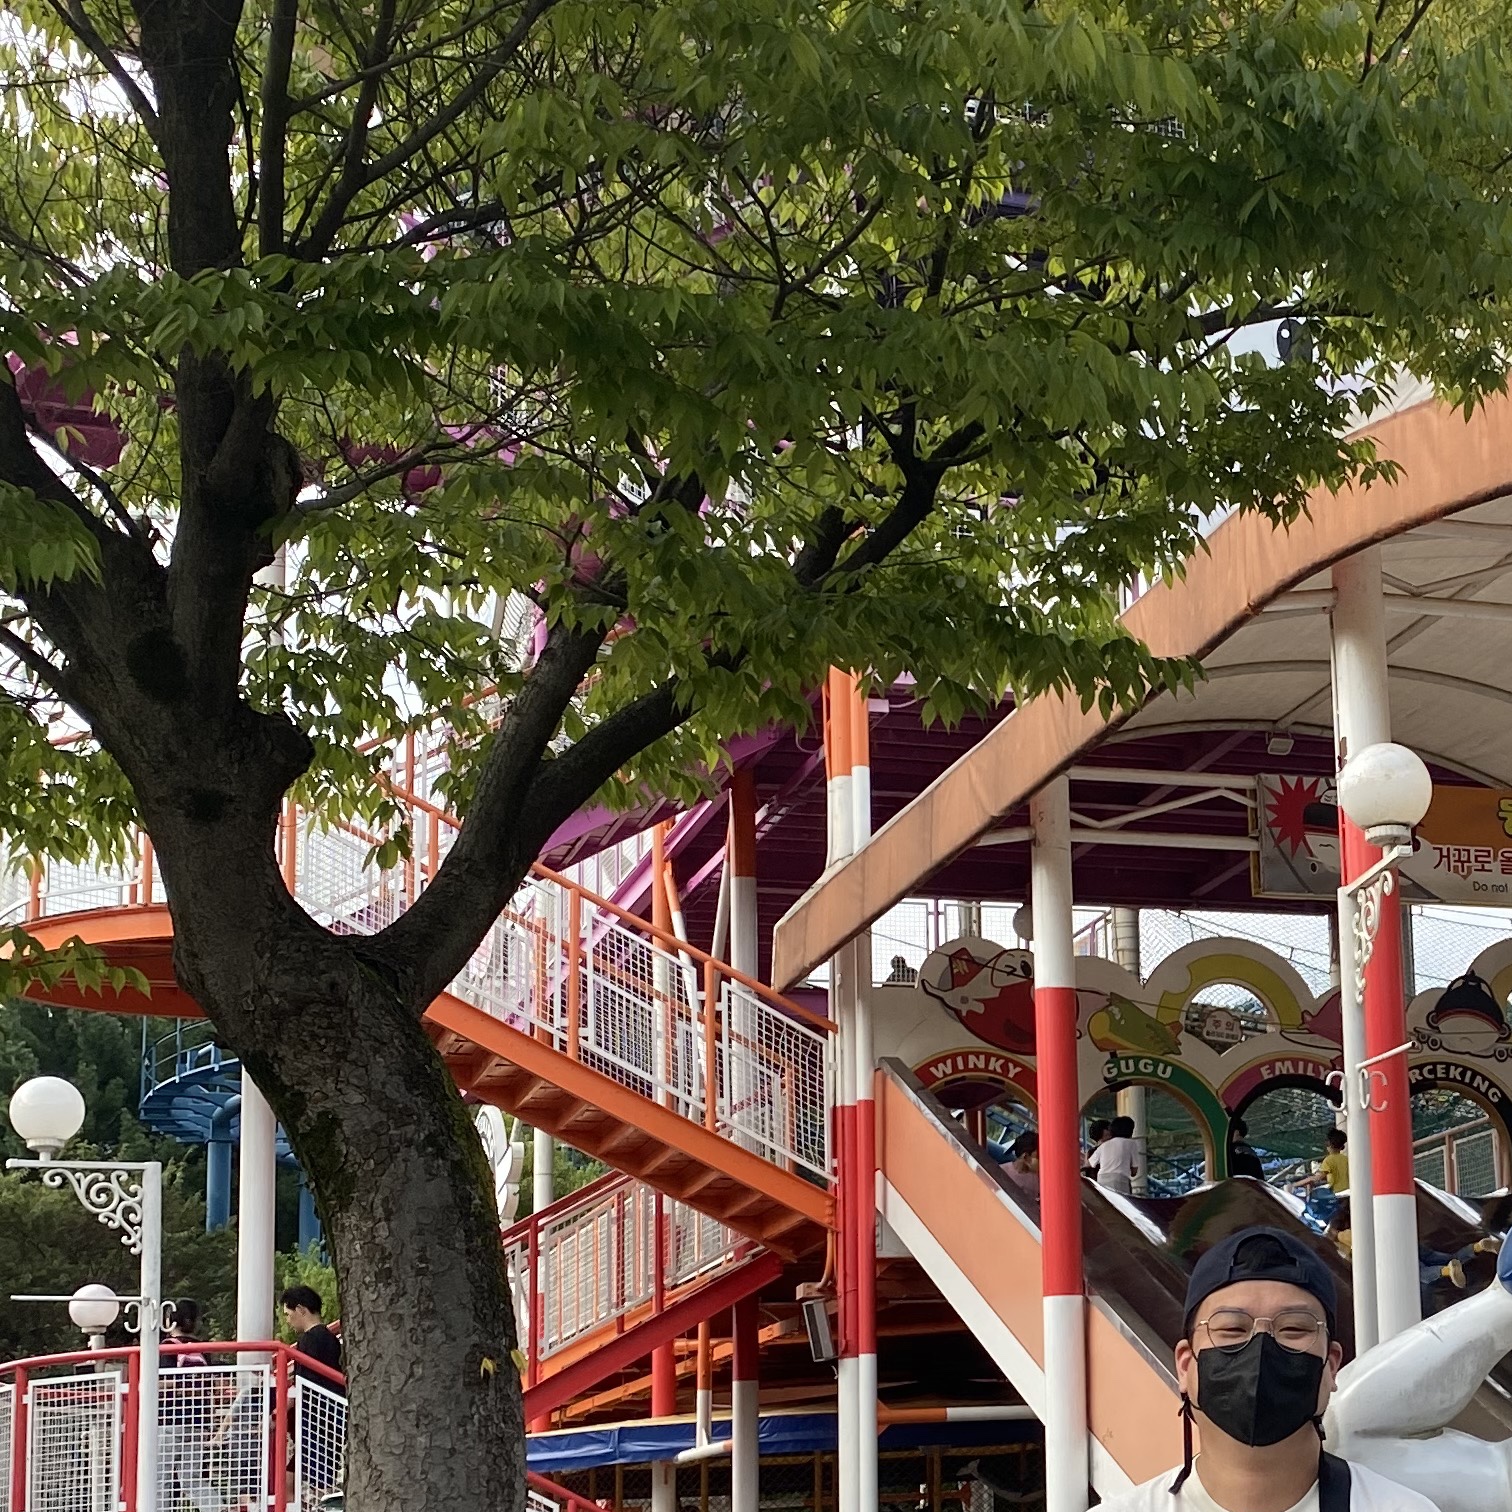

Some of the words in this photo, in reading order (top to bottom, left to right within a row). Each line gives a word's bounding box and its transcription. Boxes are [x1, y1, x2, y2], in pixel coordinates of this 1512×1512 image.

[1432, 846, 1493, 876] 거꾸로
[1472, 881, 1488, 892] Do
[1491, 882, 1508, 893] not
[928, 1054, 1023, 1080] WINKY
[1103, 1060, 1173, 1080] GUGU
[1260, 1060, 1332, 1081] EMILY
